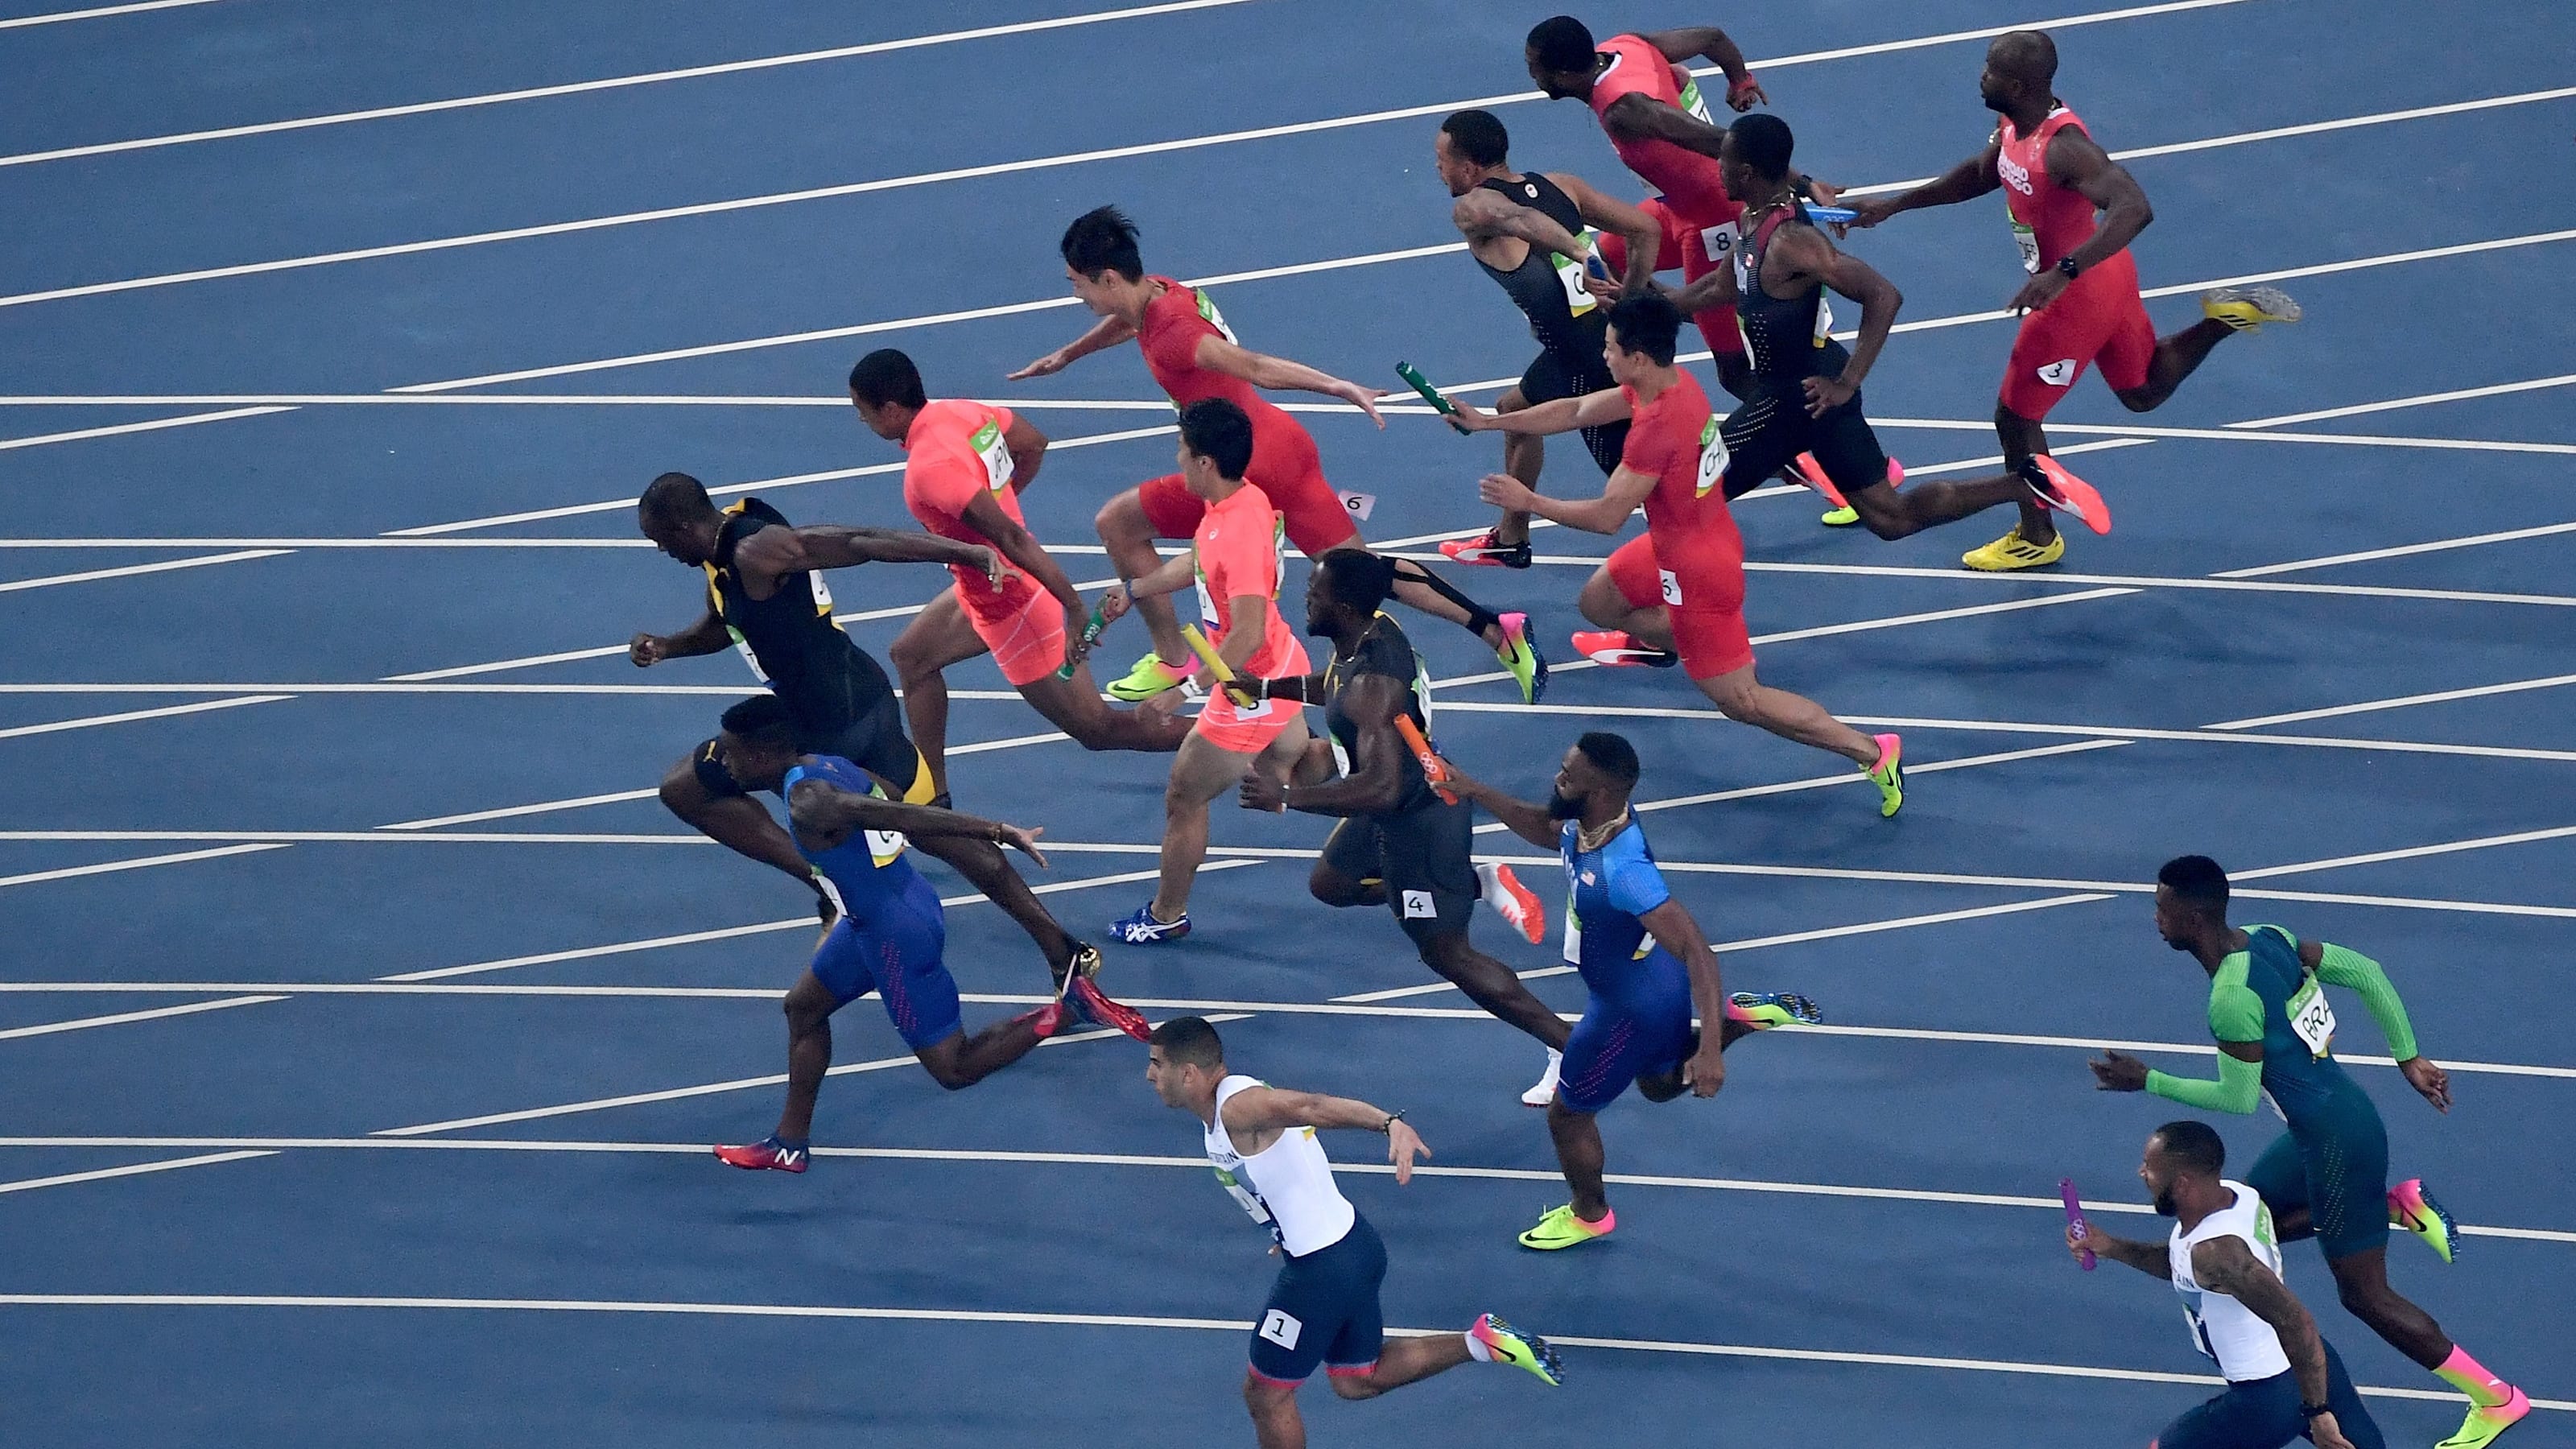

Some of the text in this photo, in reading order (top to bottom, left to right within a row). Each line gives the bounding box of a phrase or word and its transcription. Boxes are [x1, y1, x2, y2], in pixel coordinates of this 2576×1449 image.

[1715, 232, 1731, 251] 8
[2047, 363, 2062, 378] 3
[1347, 497, 1363, 510] 6
[1409, 896, 1423, 912] 4
[774, 1148, 800, 1166] N
[1272, 1318, 1285, 1338] 1
